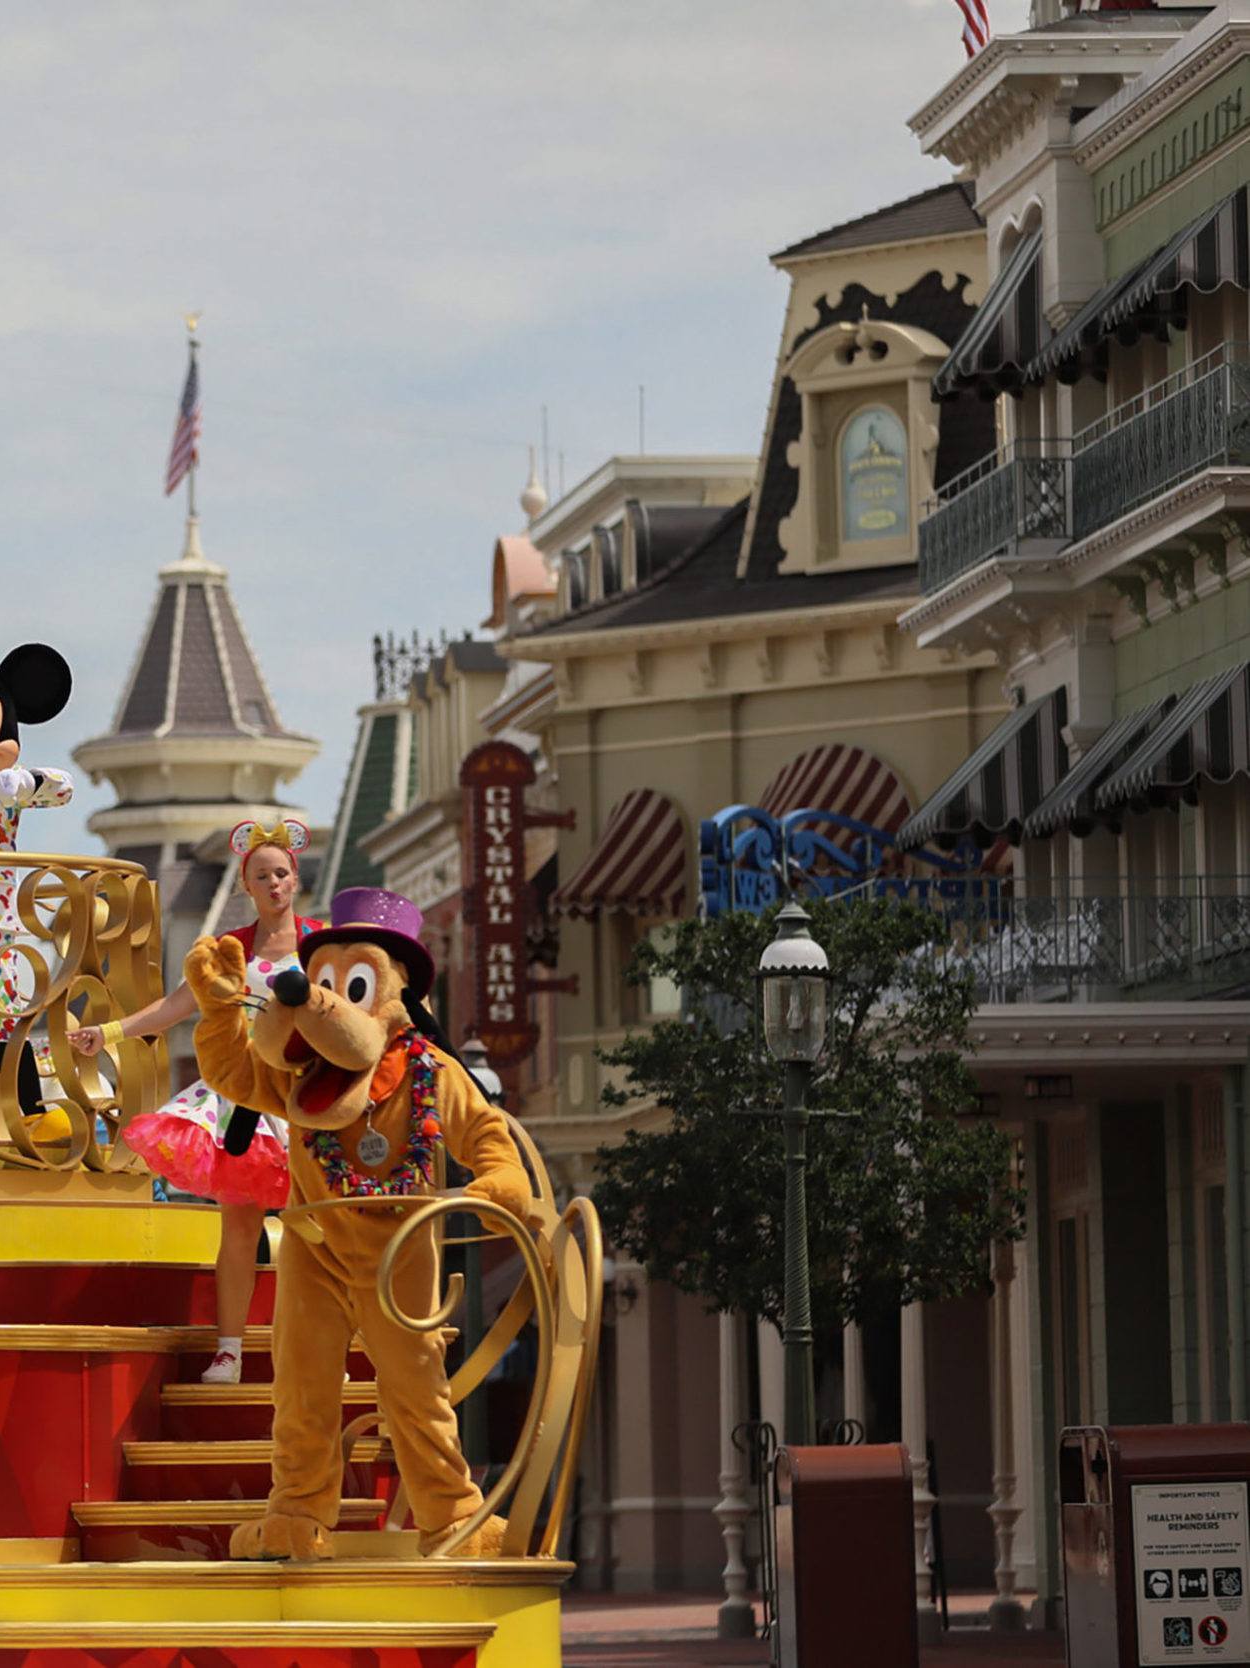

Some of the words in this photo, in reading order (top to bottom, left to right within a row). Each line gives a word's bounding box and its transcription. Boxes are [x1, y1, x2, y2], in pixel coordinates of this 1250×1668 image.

[484, 786, 513, 924] CRYSTAL
[486, 943, 515, 1022] ARTS
[1158, 1491, 1195, 1499] IMPORTANT
[1147, 1513, 1182, 1522] HEALTH
[1205, 1512, 1239, 1520] SAFETY
[1168, 1522, 1220, 1531] REMINDERS
